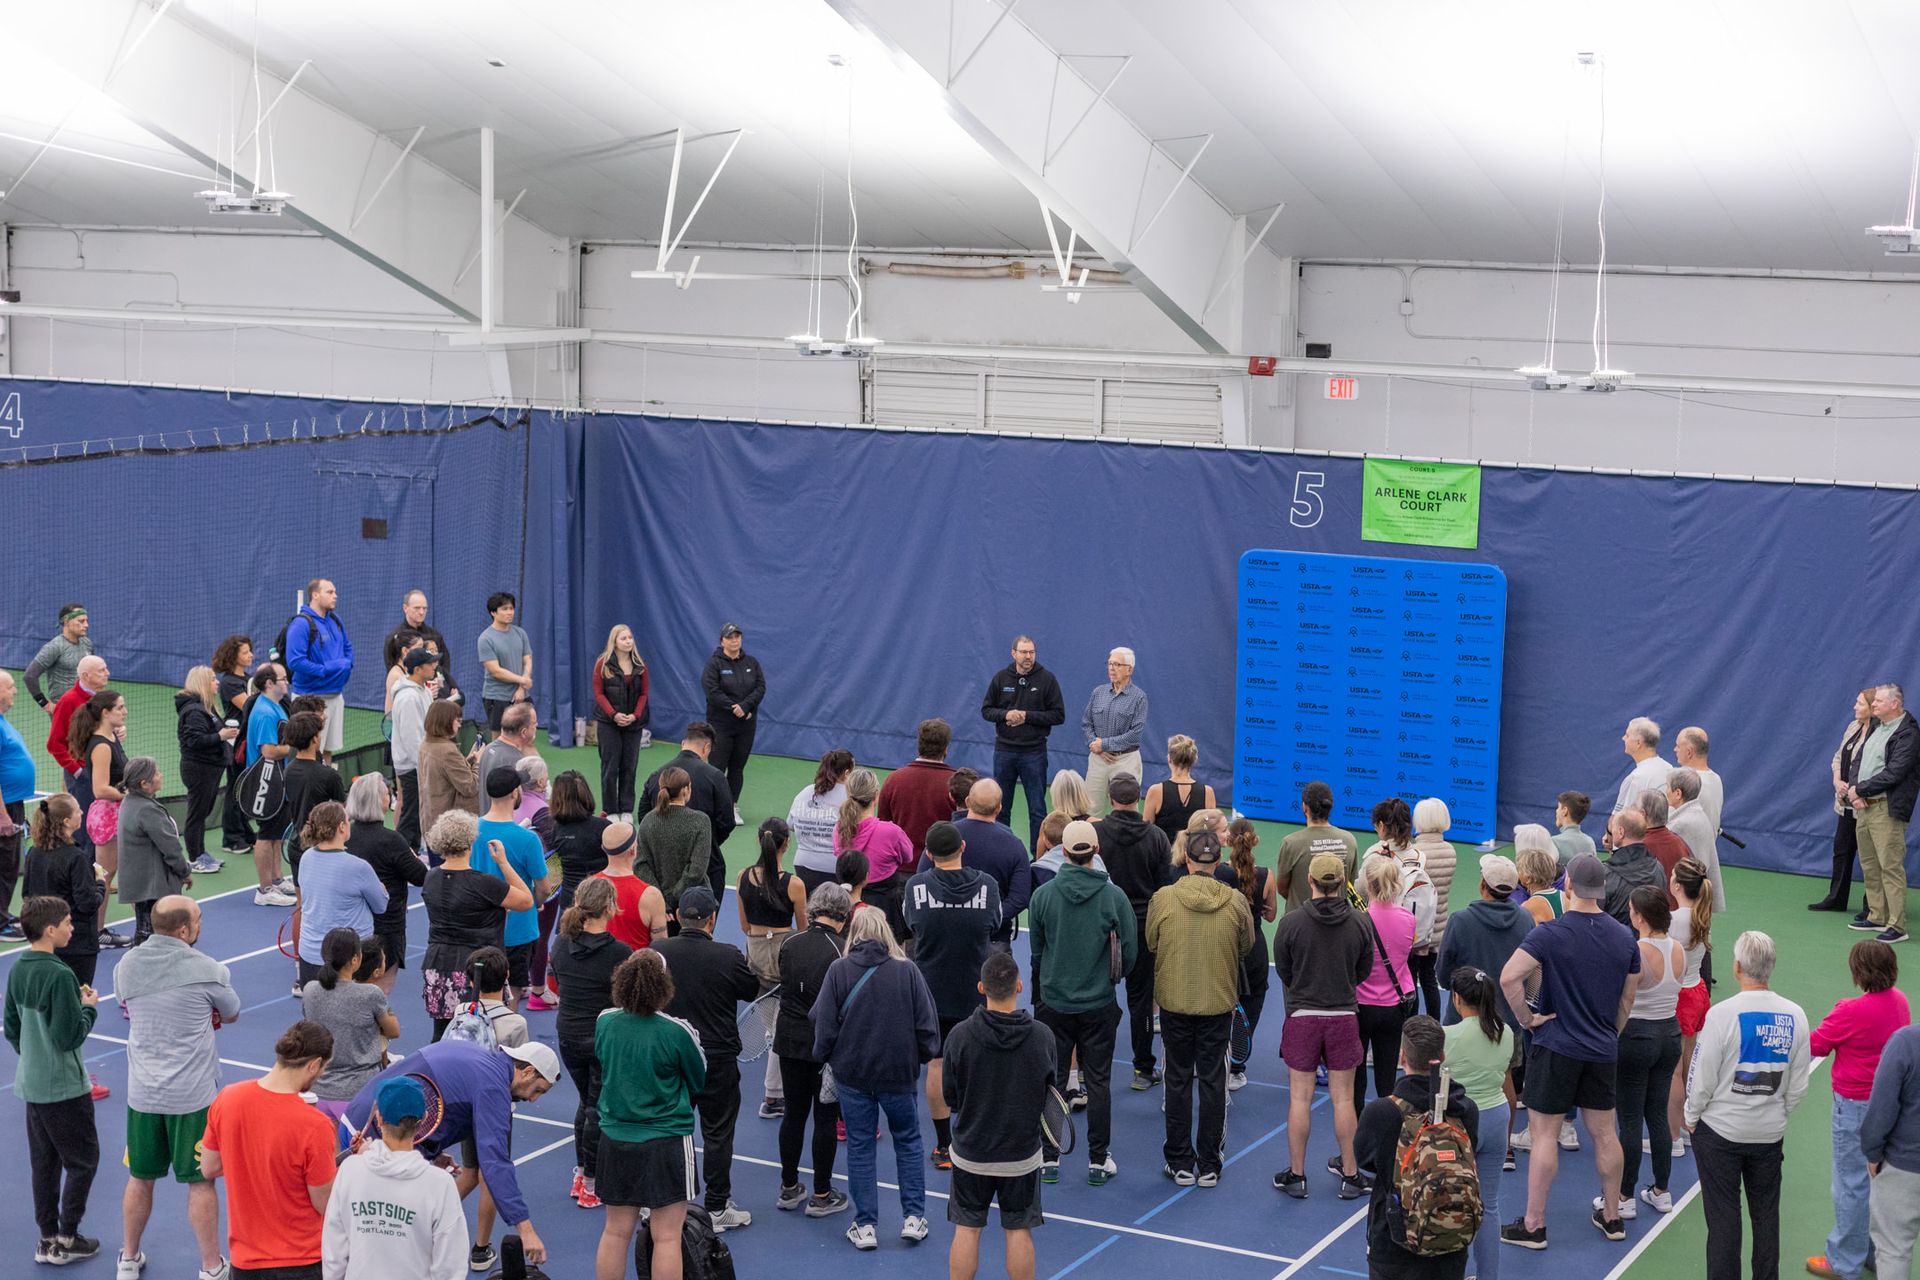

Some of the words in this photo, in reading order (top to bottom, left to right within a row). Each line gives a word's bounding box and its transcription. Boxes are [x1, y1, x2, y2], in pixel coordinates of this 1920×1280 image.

[1330, 378, 1354, 398] EXIT
[0, 392, 23, 438] 4
[1290, 471, 1324, 528] 5
[1375, 487, 1420, 499] ARLENE
[1427, 491, 1467, 502] CLARK
[1400, 500, 1442, 512] COURT
[1300, 622, 1318, 630] USTA
[1245, 756, 1263, 764] USTA
[252, 758, 274, 815] EAD
[1452, 818, 1471, 826] USTA
[1775, 1015, 1793, 1027] USTA
[1756, 1025, 1792, 1037] NATIONAL
[1762, 1036, 1792, 1048] CAMPUS
[352, 1201, 416, 1225] EASTSIDE
[357, 1227, 394, 1236] PORTLAND
